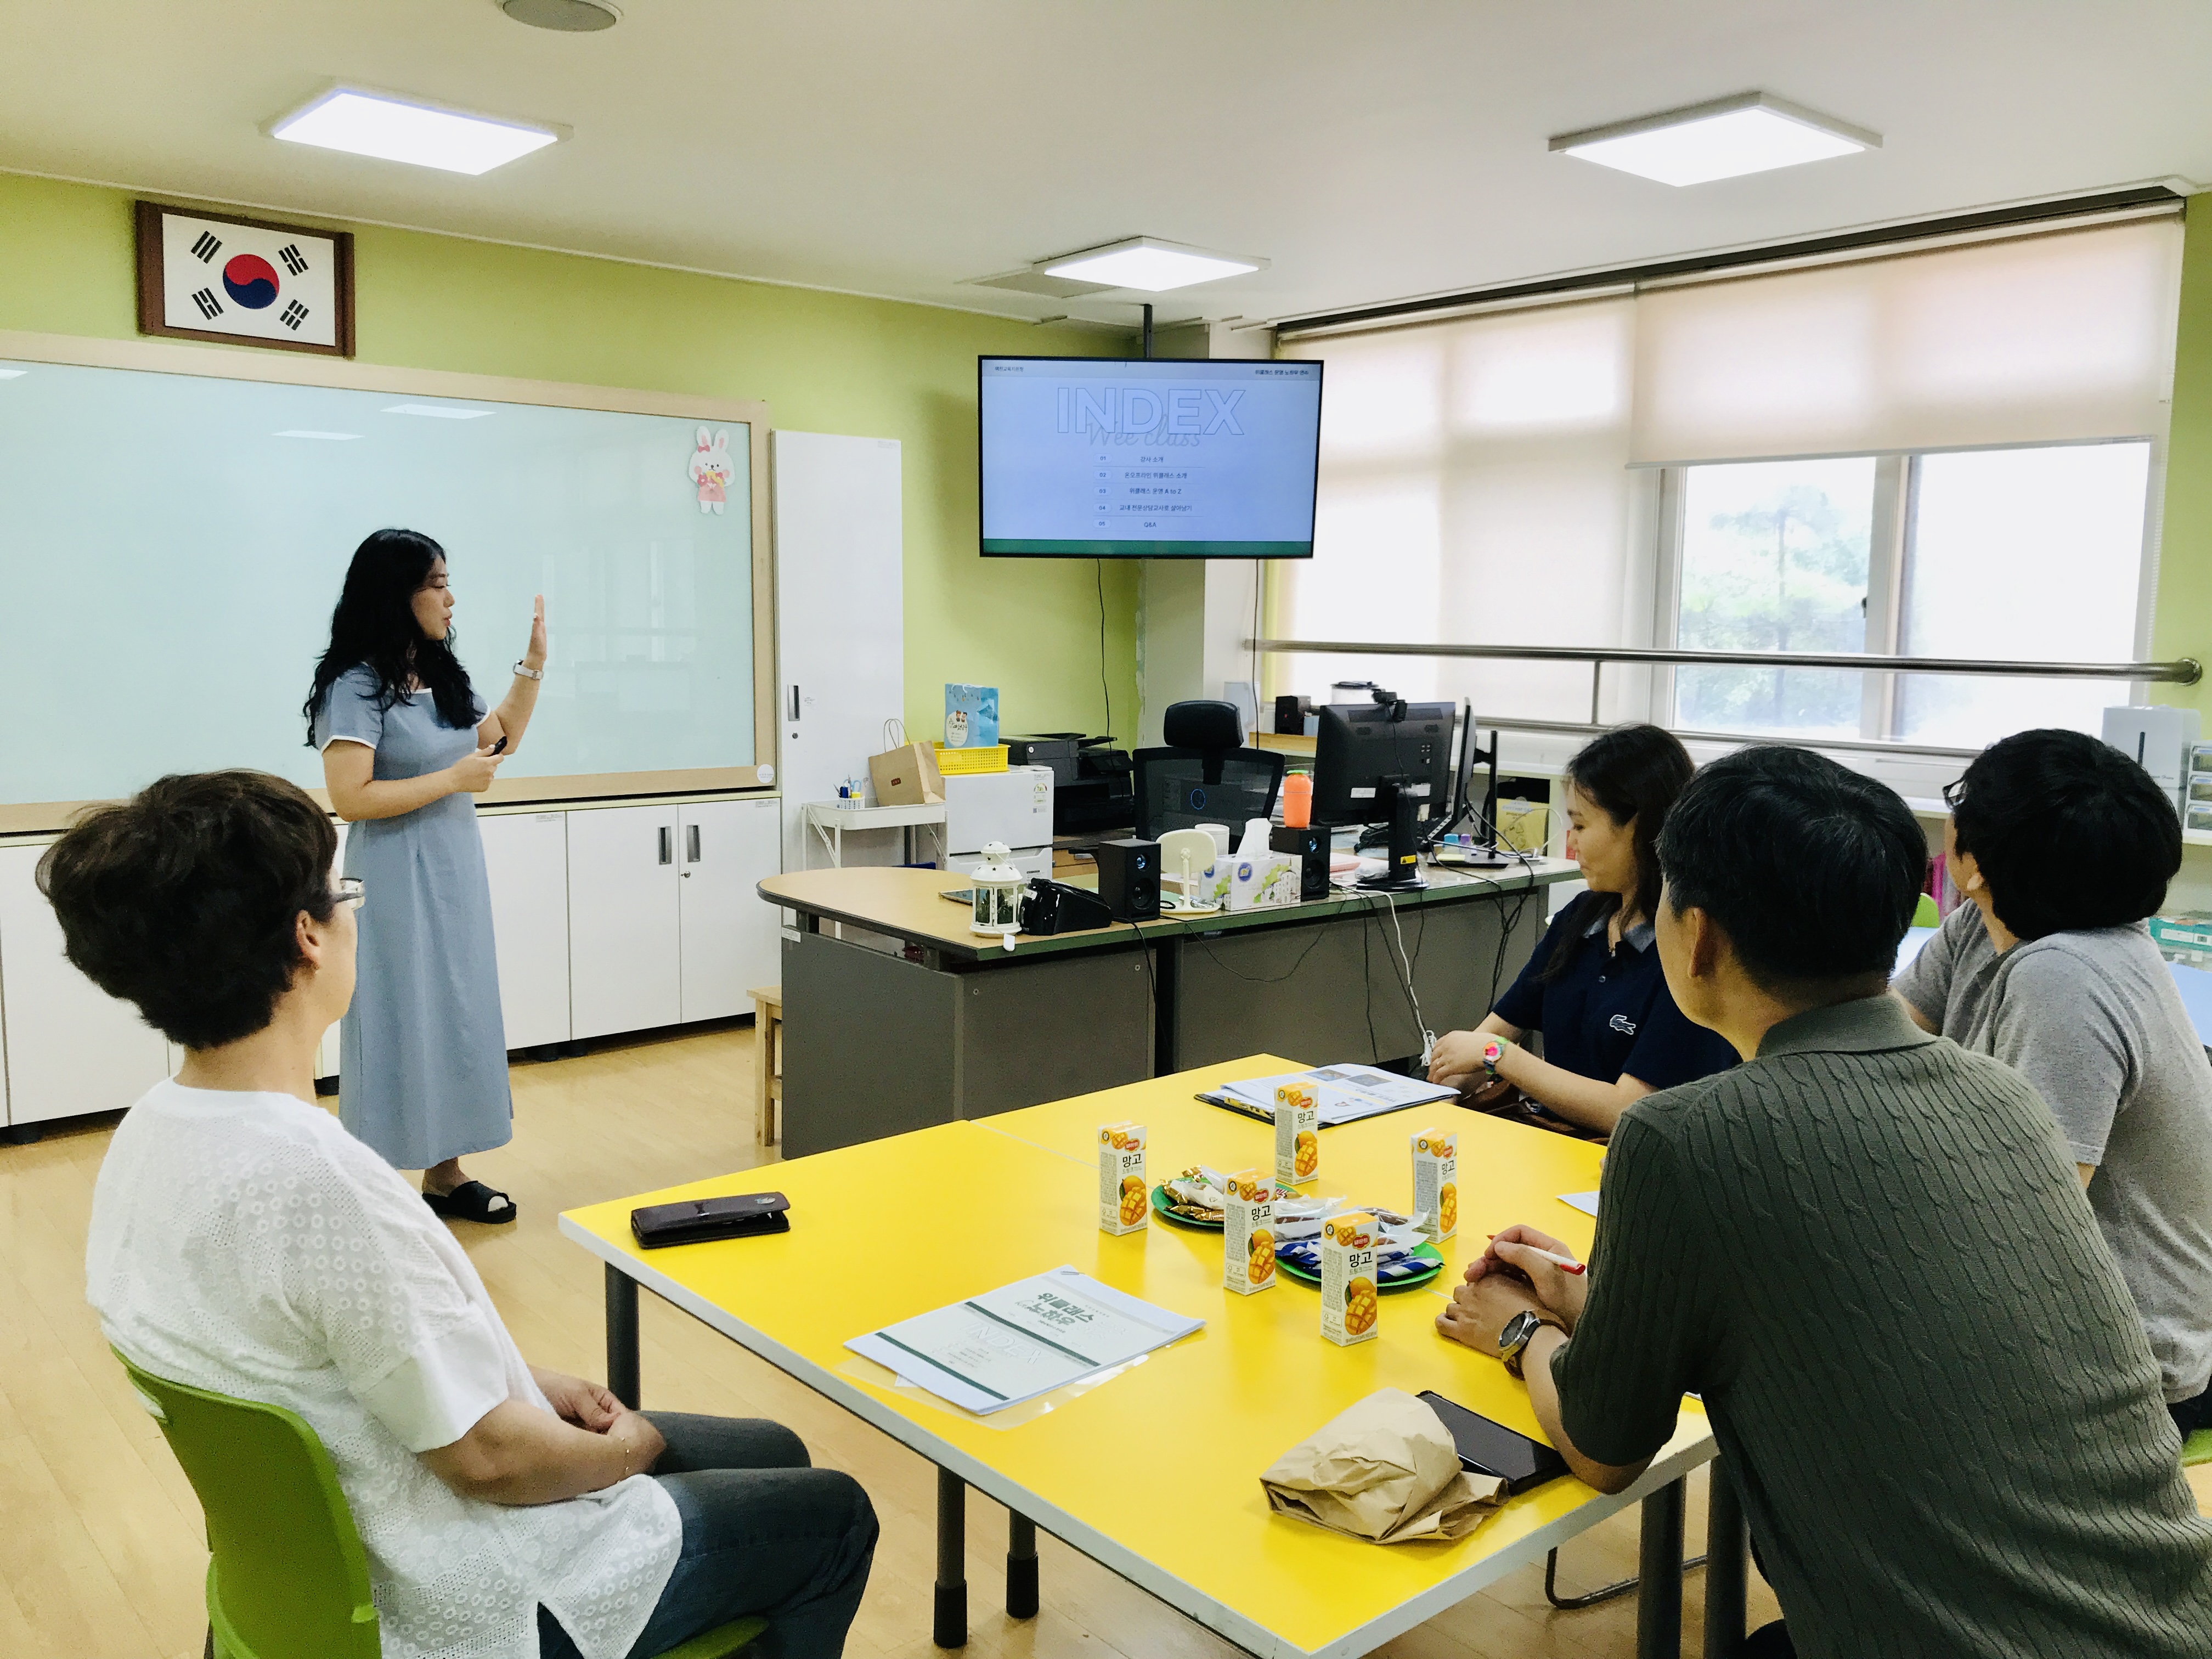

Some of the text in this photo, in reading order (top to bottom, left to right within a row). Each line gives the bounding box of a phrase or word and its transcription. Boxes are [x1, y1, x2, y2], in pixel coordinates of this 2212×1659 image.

[1057, 387, 1246, 435] INDEX
[1087, 414, 1200, 447] Wee class
[1297, 1110, 1315, 1124] 망고
[1122, 1153, 1142, 1167] 망고
[1441, 1160, 1455, 1175] 망고
[1251, 1205, 1271, 1221] 망고
[1350, 1251, 1373, 1268] 망고
[1348, 1267, 1363, 1275] 드링크
